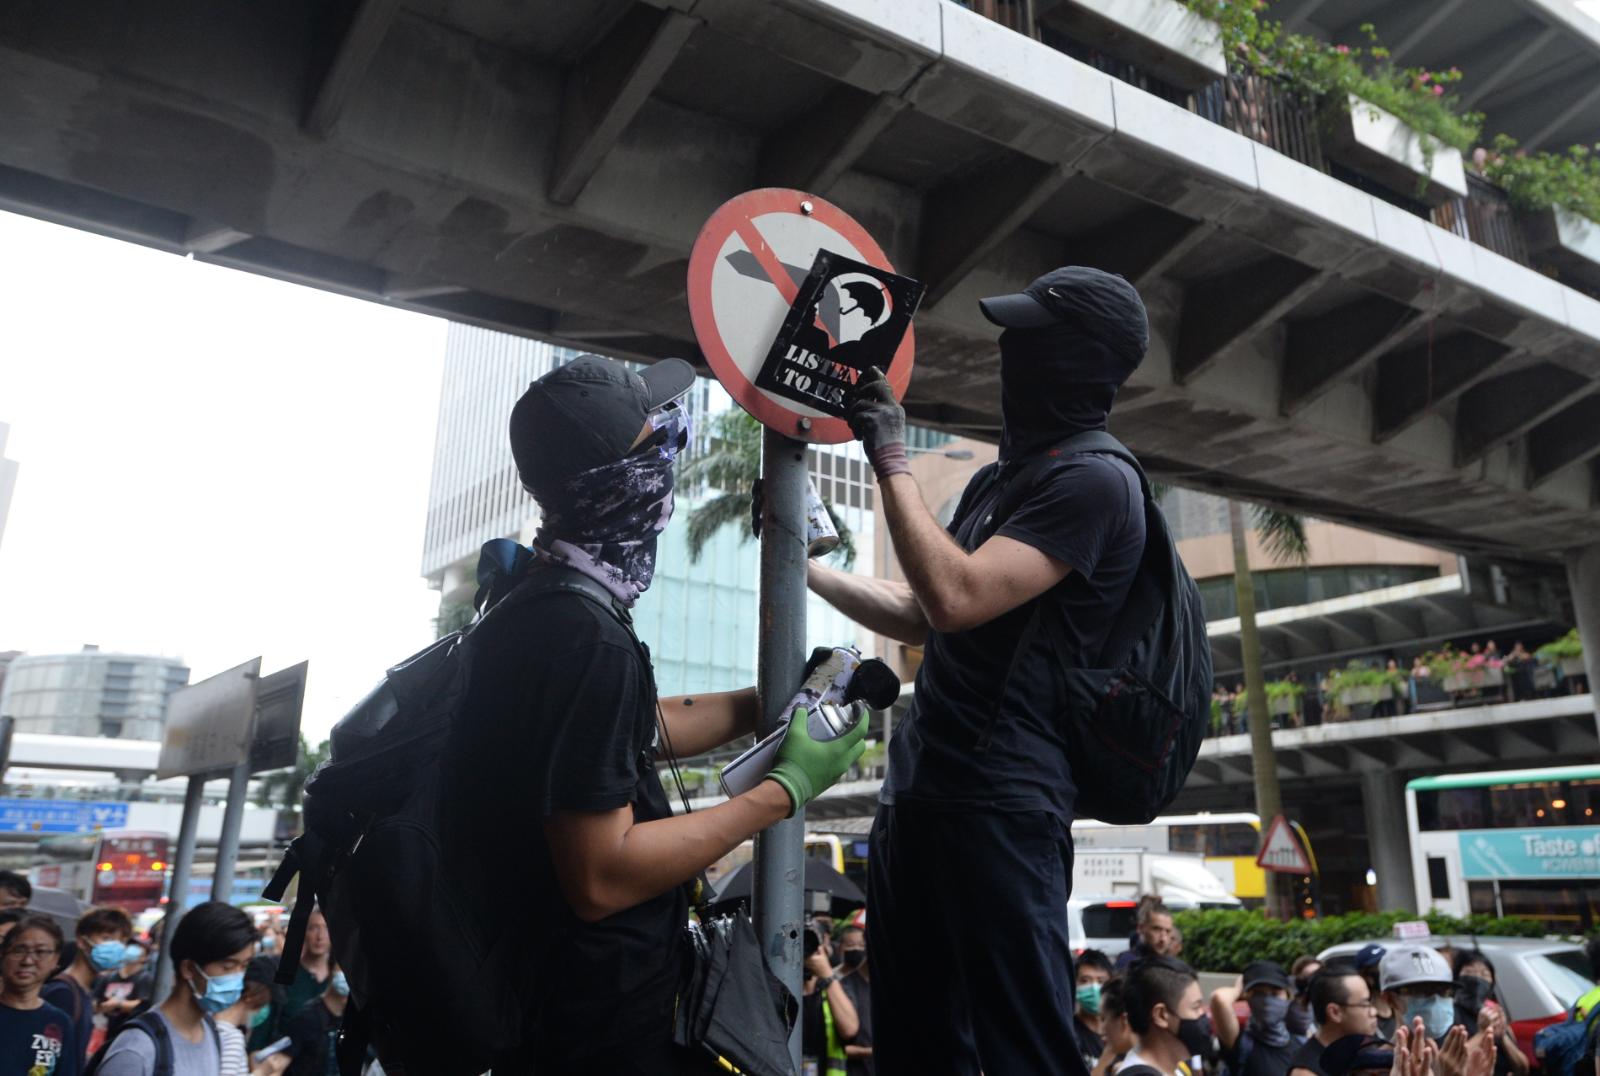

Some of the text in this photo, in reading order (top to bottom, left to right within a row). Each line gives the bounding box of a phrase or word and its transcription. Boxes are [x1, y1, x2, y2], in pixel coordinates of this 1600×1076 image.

[785, 344, 862, 385] LISTEN
[783, 368, 845, 407] TO US
[1521, 833, 1577, 857] Taste
